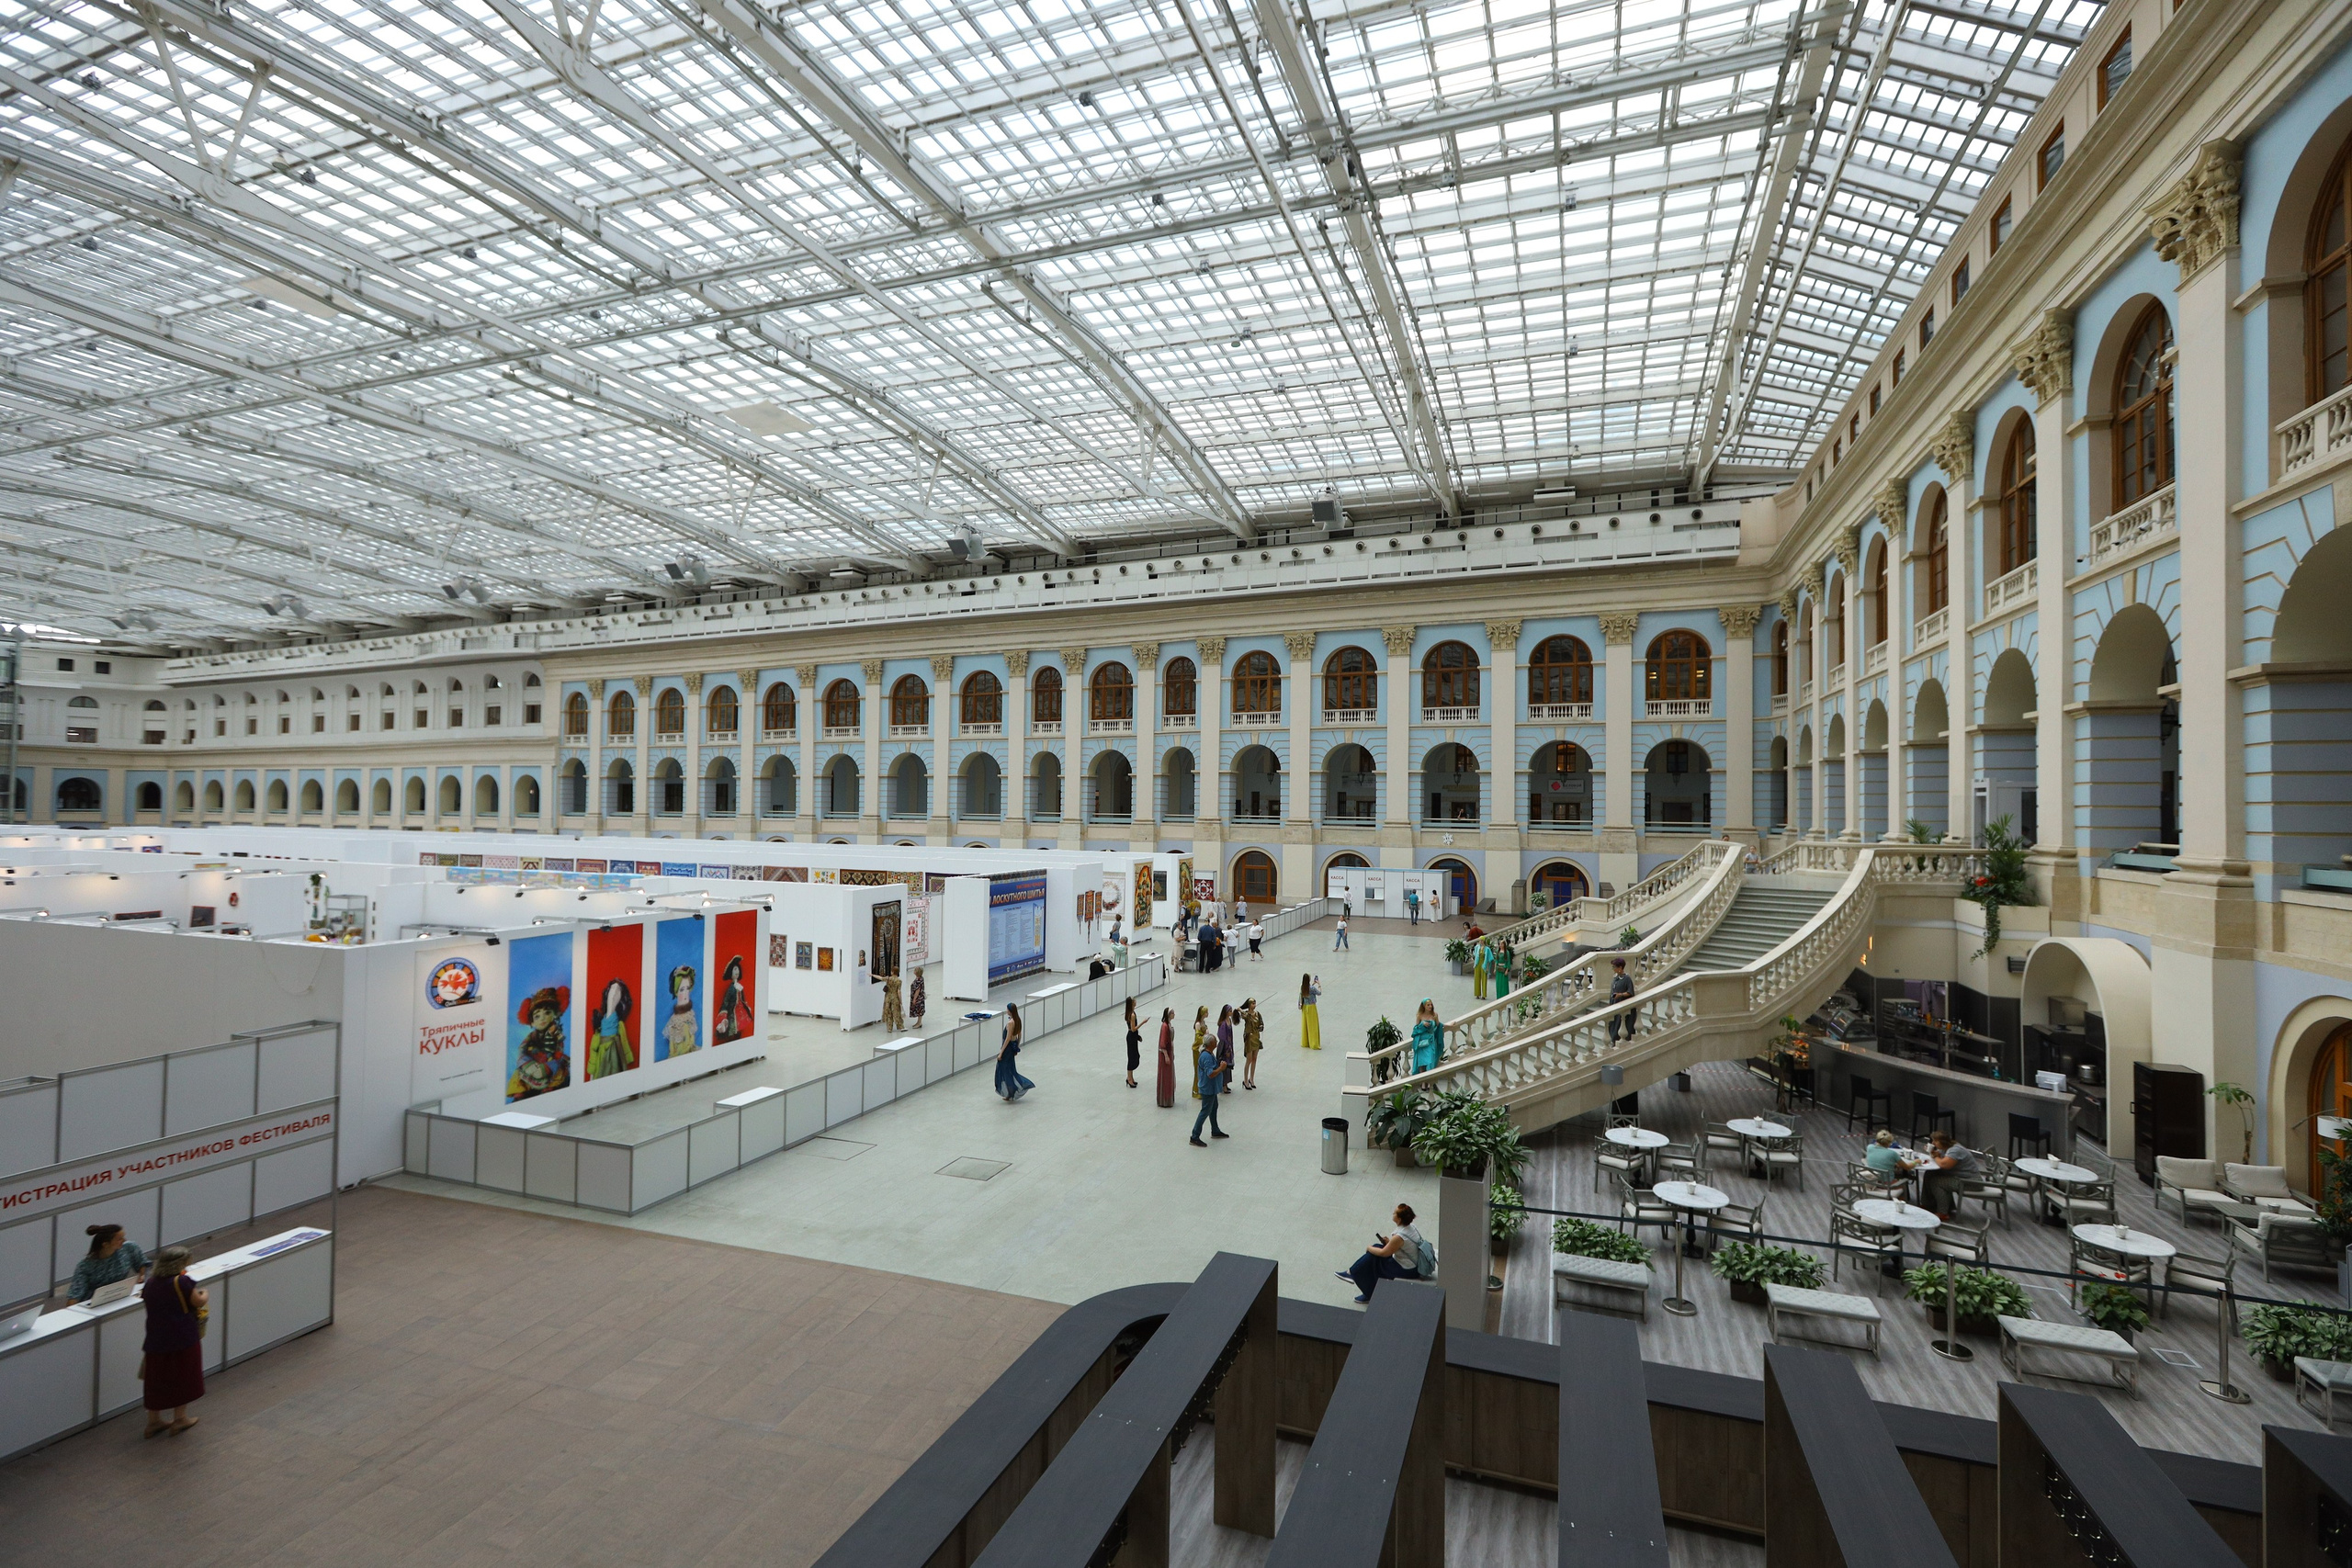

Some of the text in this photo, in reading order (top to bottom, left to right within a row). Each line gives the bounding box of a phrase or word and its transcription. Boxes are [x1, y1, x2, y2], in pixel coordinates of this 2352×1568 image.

[992, 891, 1026, 905] ЛОСКУТНОГО
[1027, 887, 1045, 899] ШИТЬЯ
[420, 1019, 485, 1039] Тряпичные
[0, 1113, 332, 1209] ИСТРАЦИЯ УЧАСТНИКОВ ФЕСТИВАЛЯ
